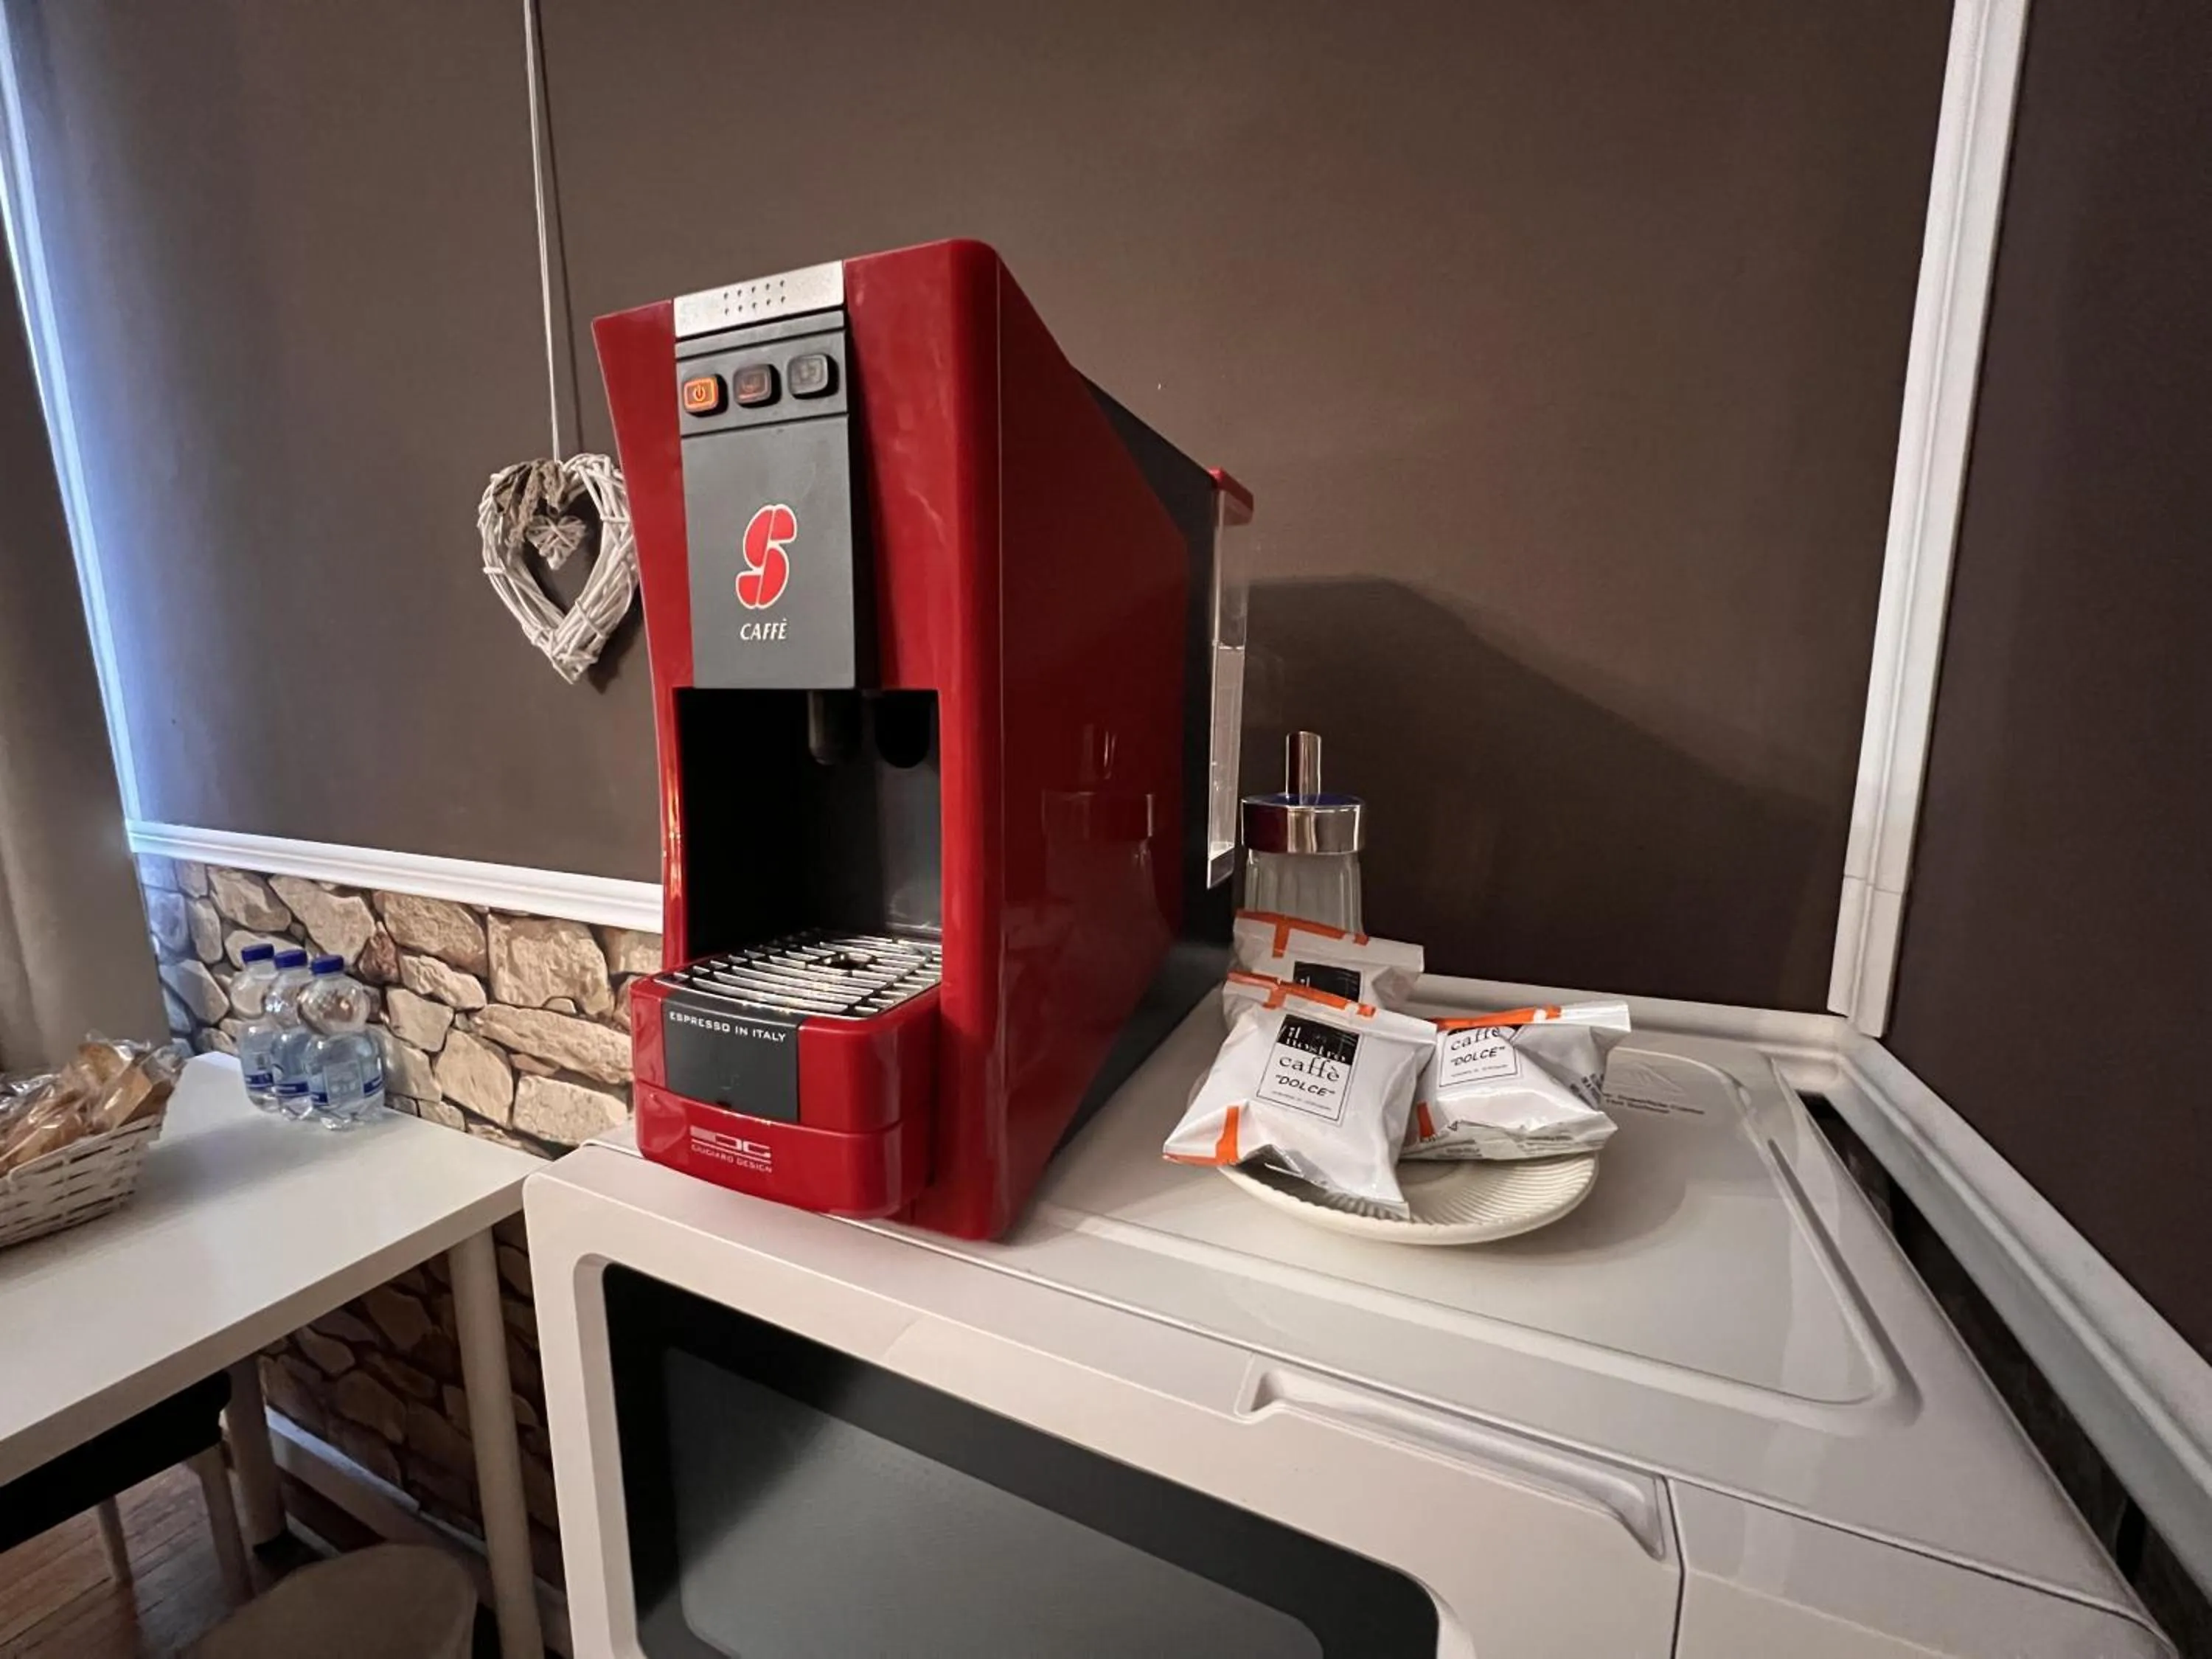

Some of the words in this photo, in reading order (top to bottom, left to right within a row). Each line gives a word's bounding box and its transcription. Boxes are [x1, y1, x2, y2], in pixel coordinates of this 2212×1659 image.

[740, 618, 788, 641] CAFFÈ
[669, 1011, 731, 1032] ESPRESSO
[735, 1025, 748, 1036] IN
[753, 1029, 787, 1043] ITALY
[1279, 1055, 1340, 1082] caffè
